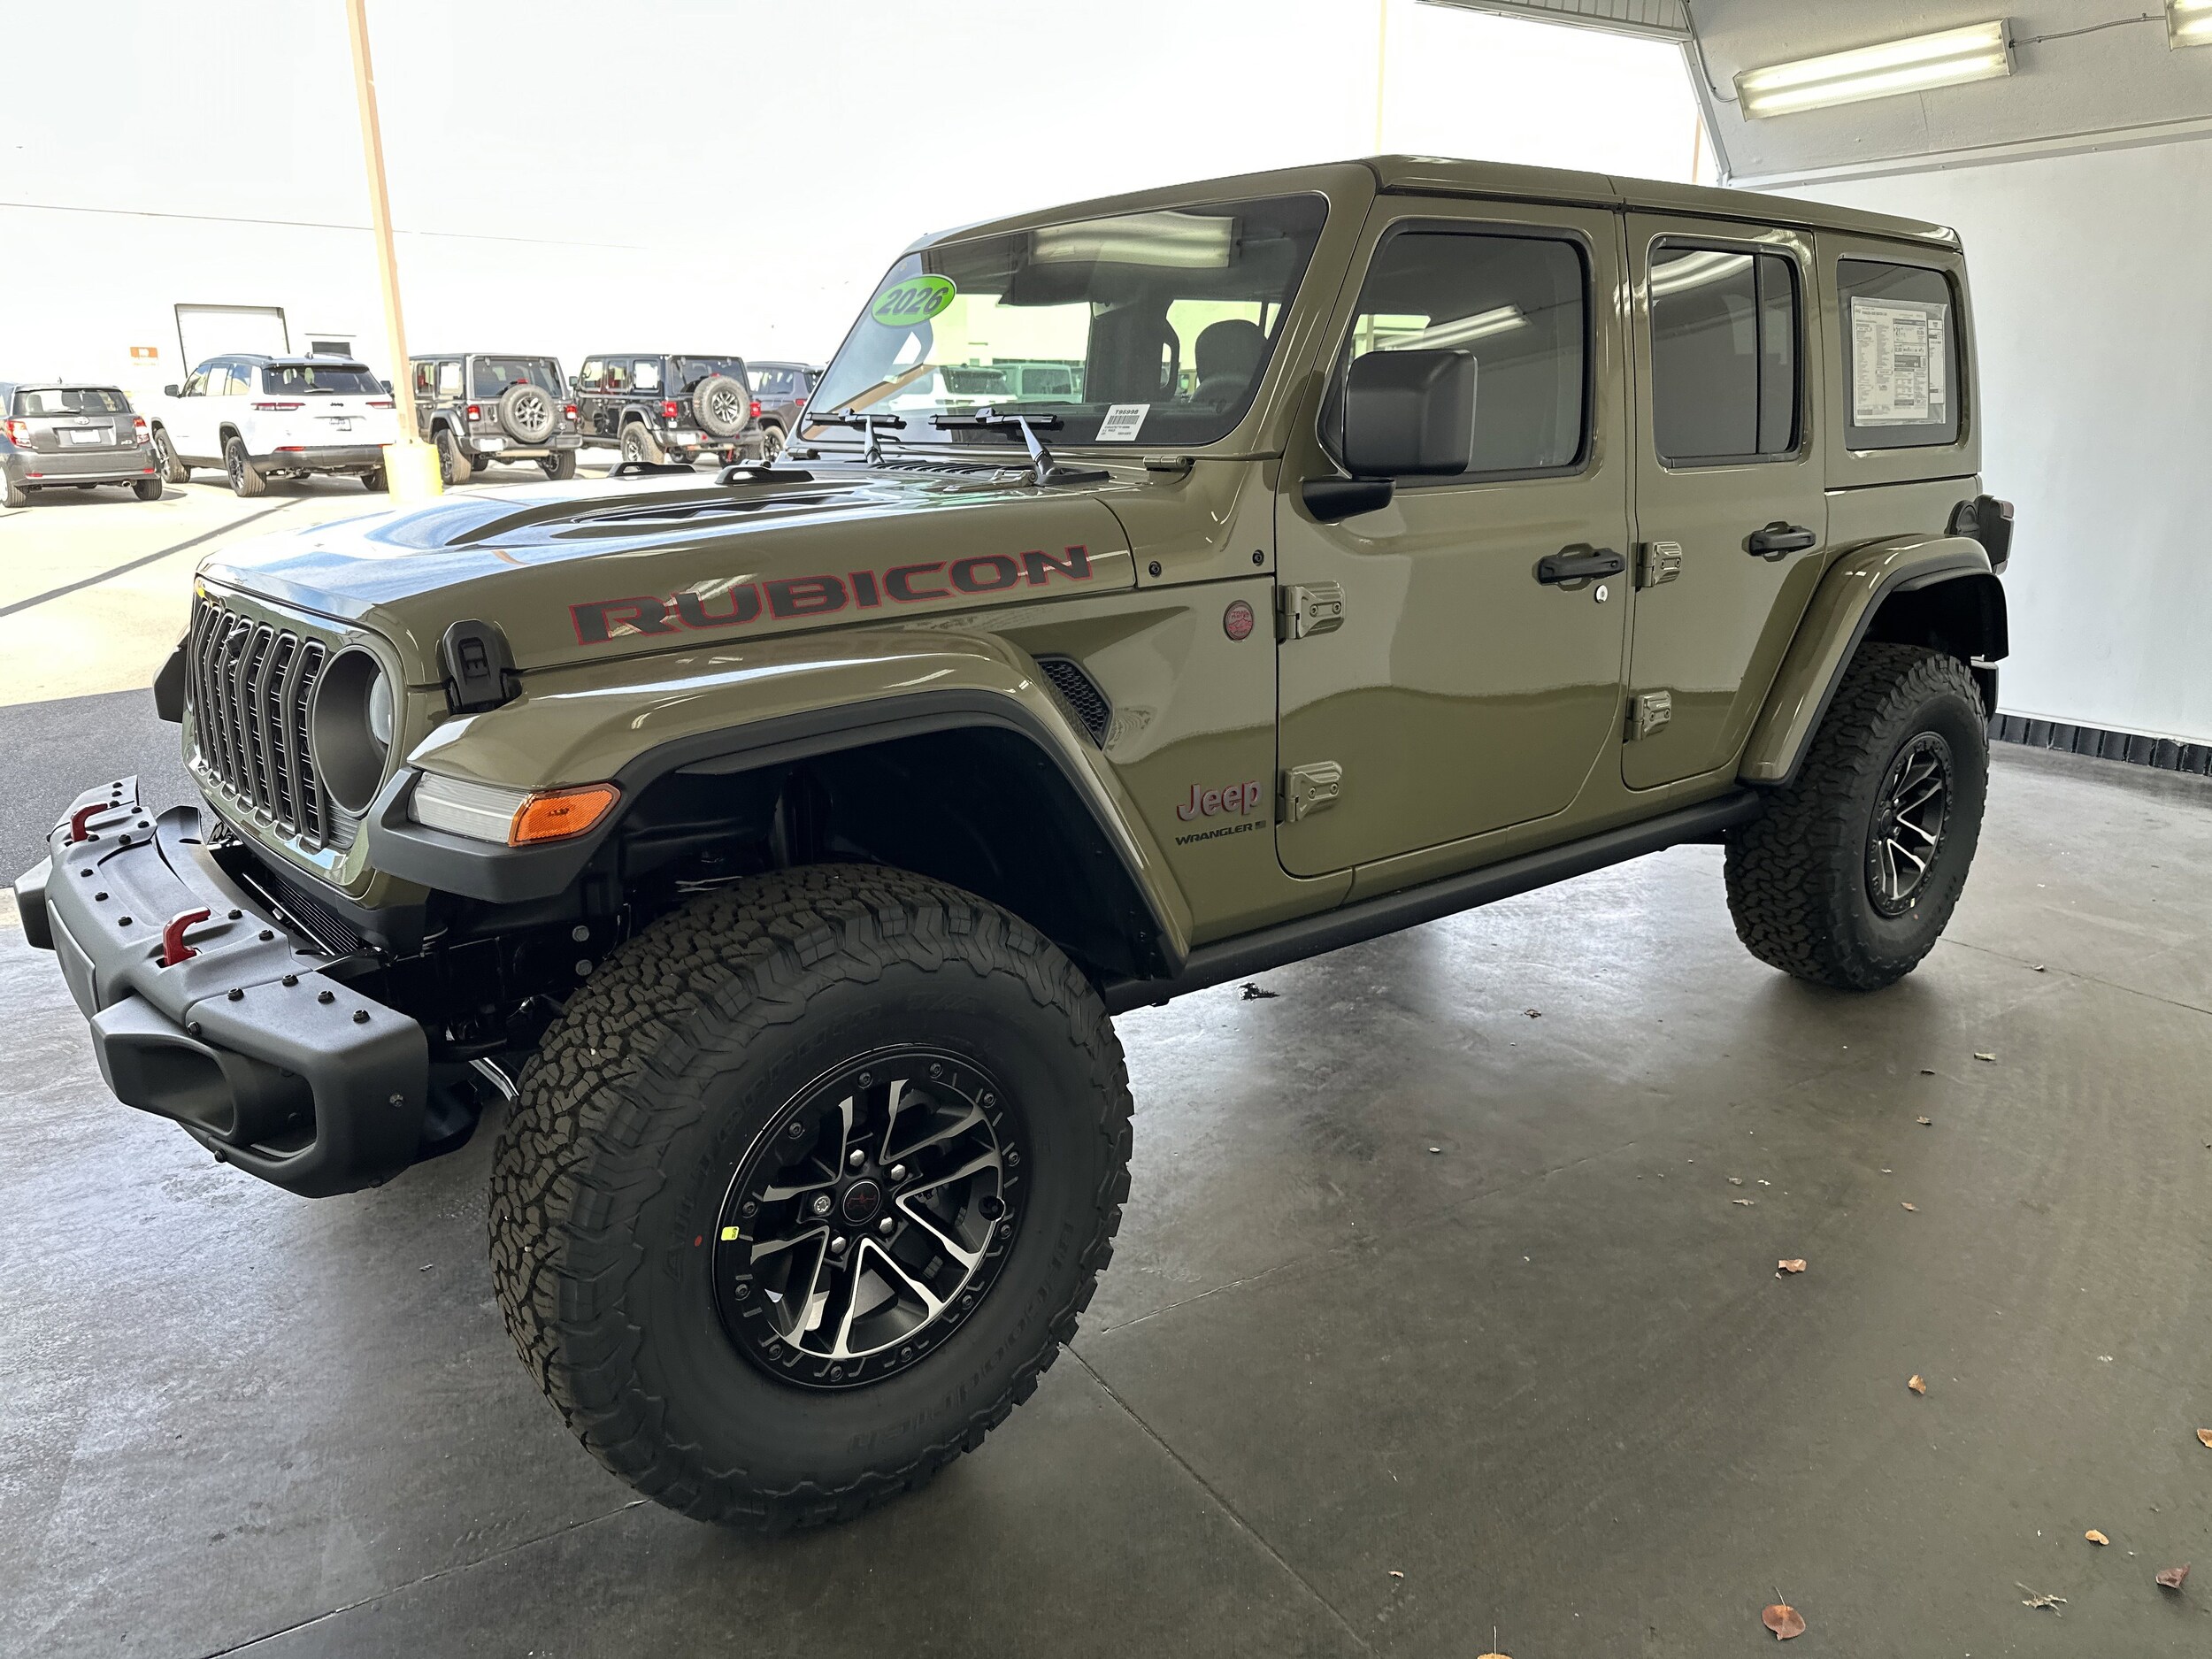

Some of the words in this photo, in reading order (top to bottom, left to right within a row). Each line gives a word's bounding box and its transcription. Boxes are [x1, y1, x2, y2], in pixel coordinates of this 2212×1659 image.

[875, 287, 949, 316] 2026
[569, 545, 1094, 645] RUBICON
[1177, 780, 1261, 821] Jeep
[1175, 823, 1253, 846] WRANGLER
